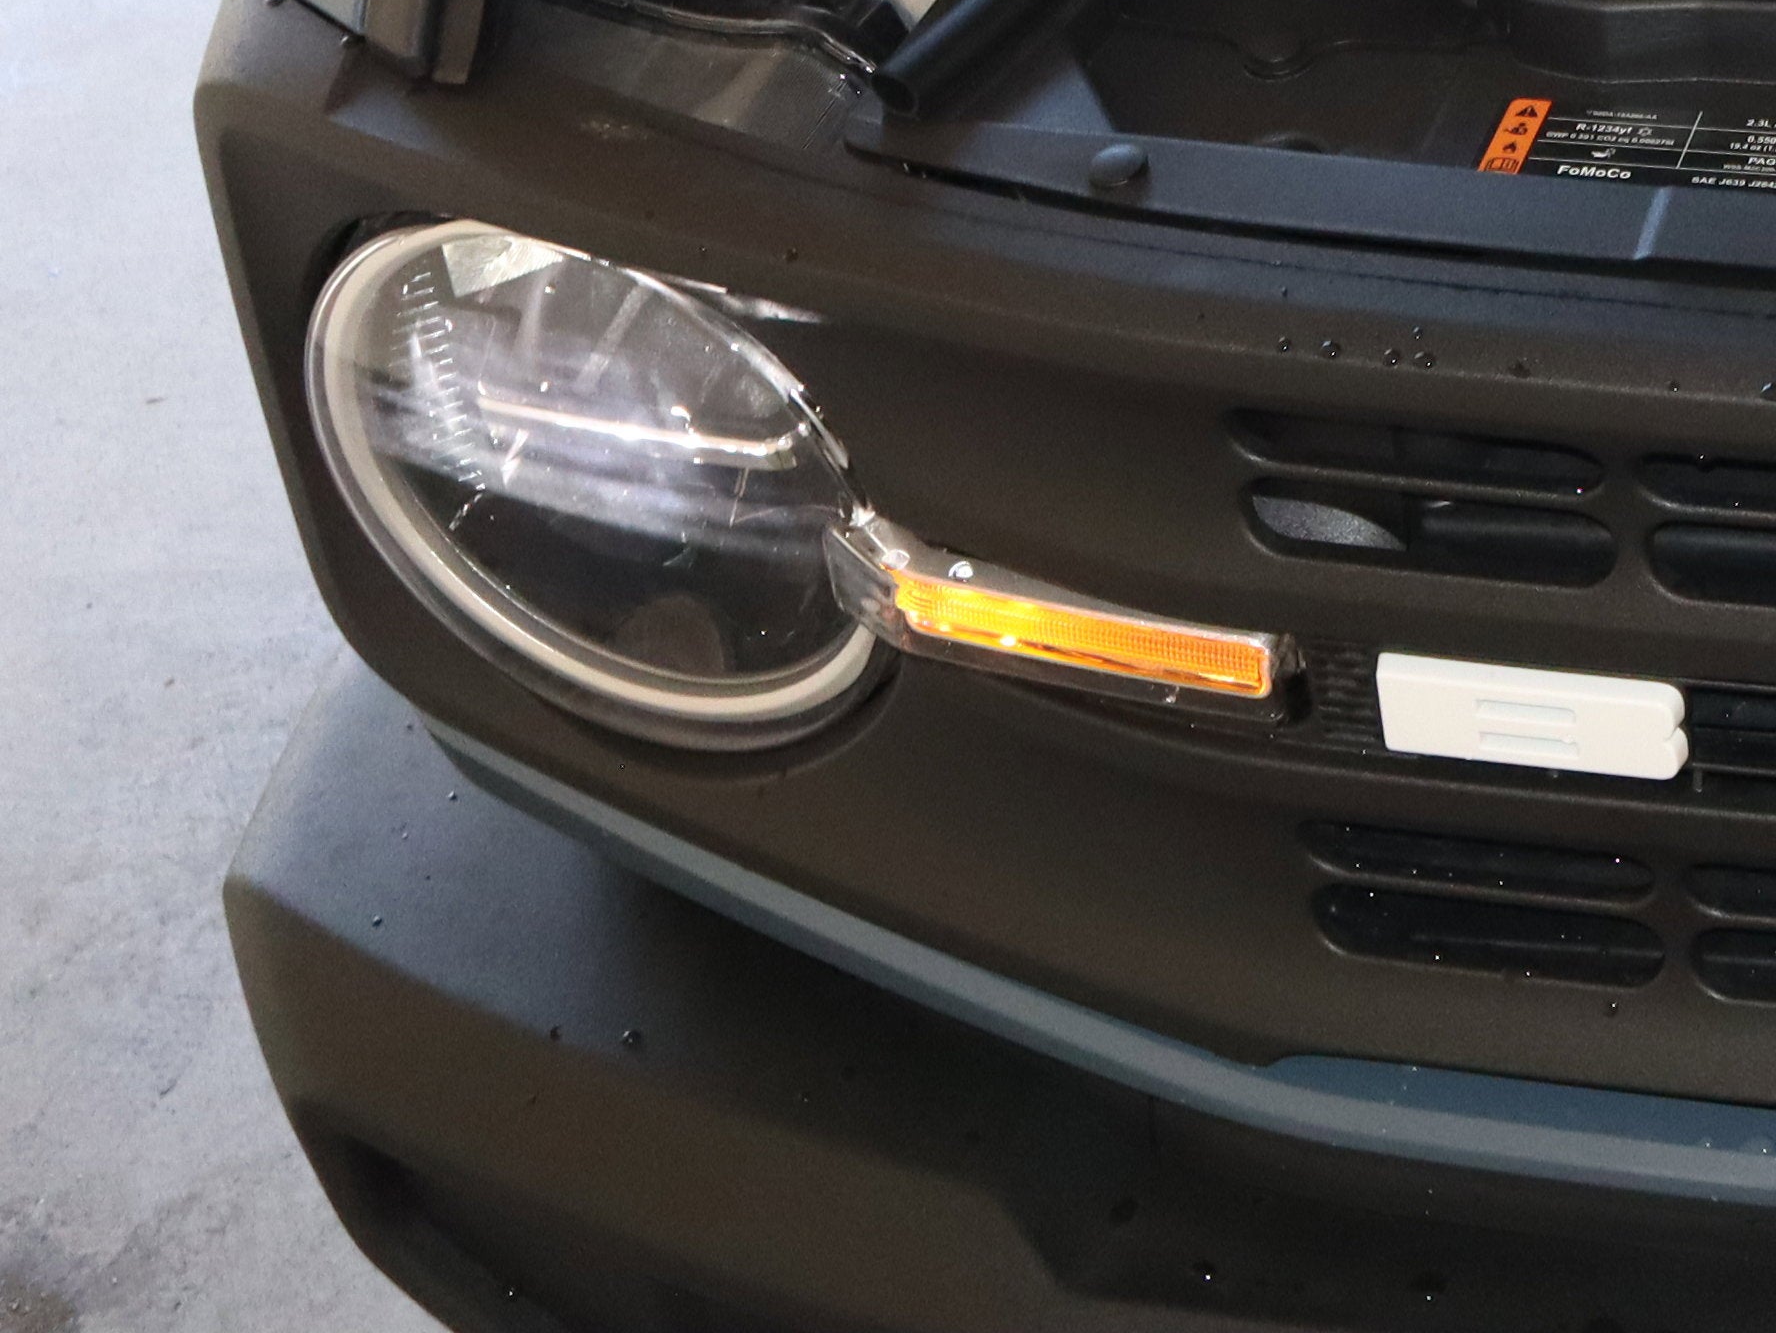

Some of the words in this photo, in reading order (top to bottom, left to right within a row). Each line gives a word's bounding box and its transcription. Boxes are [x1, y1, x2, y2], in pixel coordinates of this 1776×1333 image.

[1575, 122, 1633, 136] R-1234yf
[1746, 118, 1772, 128] 2.3L
[1557, 164, 1632, 179] FoMoCo
[1691, 176, 1717, 185] SAE
[1718, 178, 1746, 187] J639
